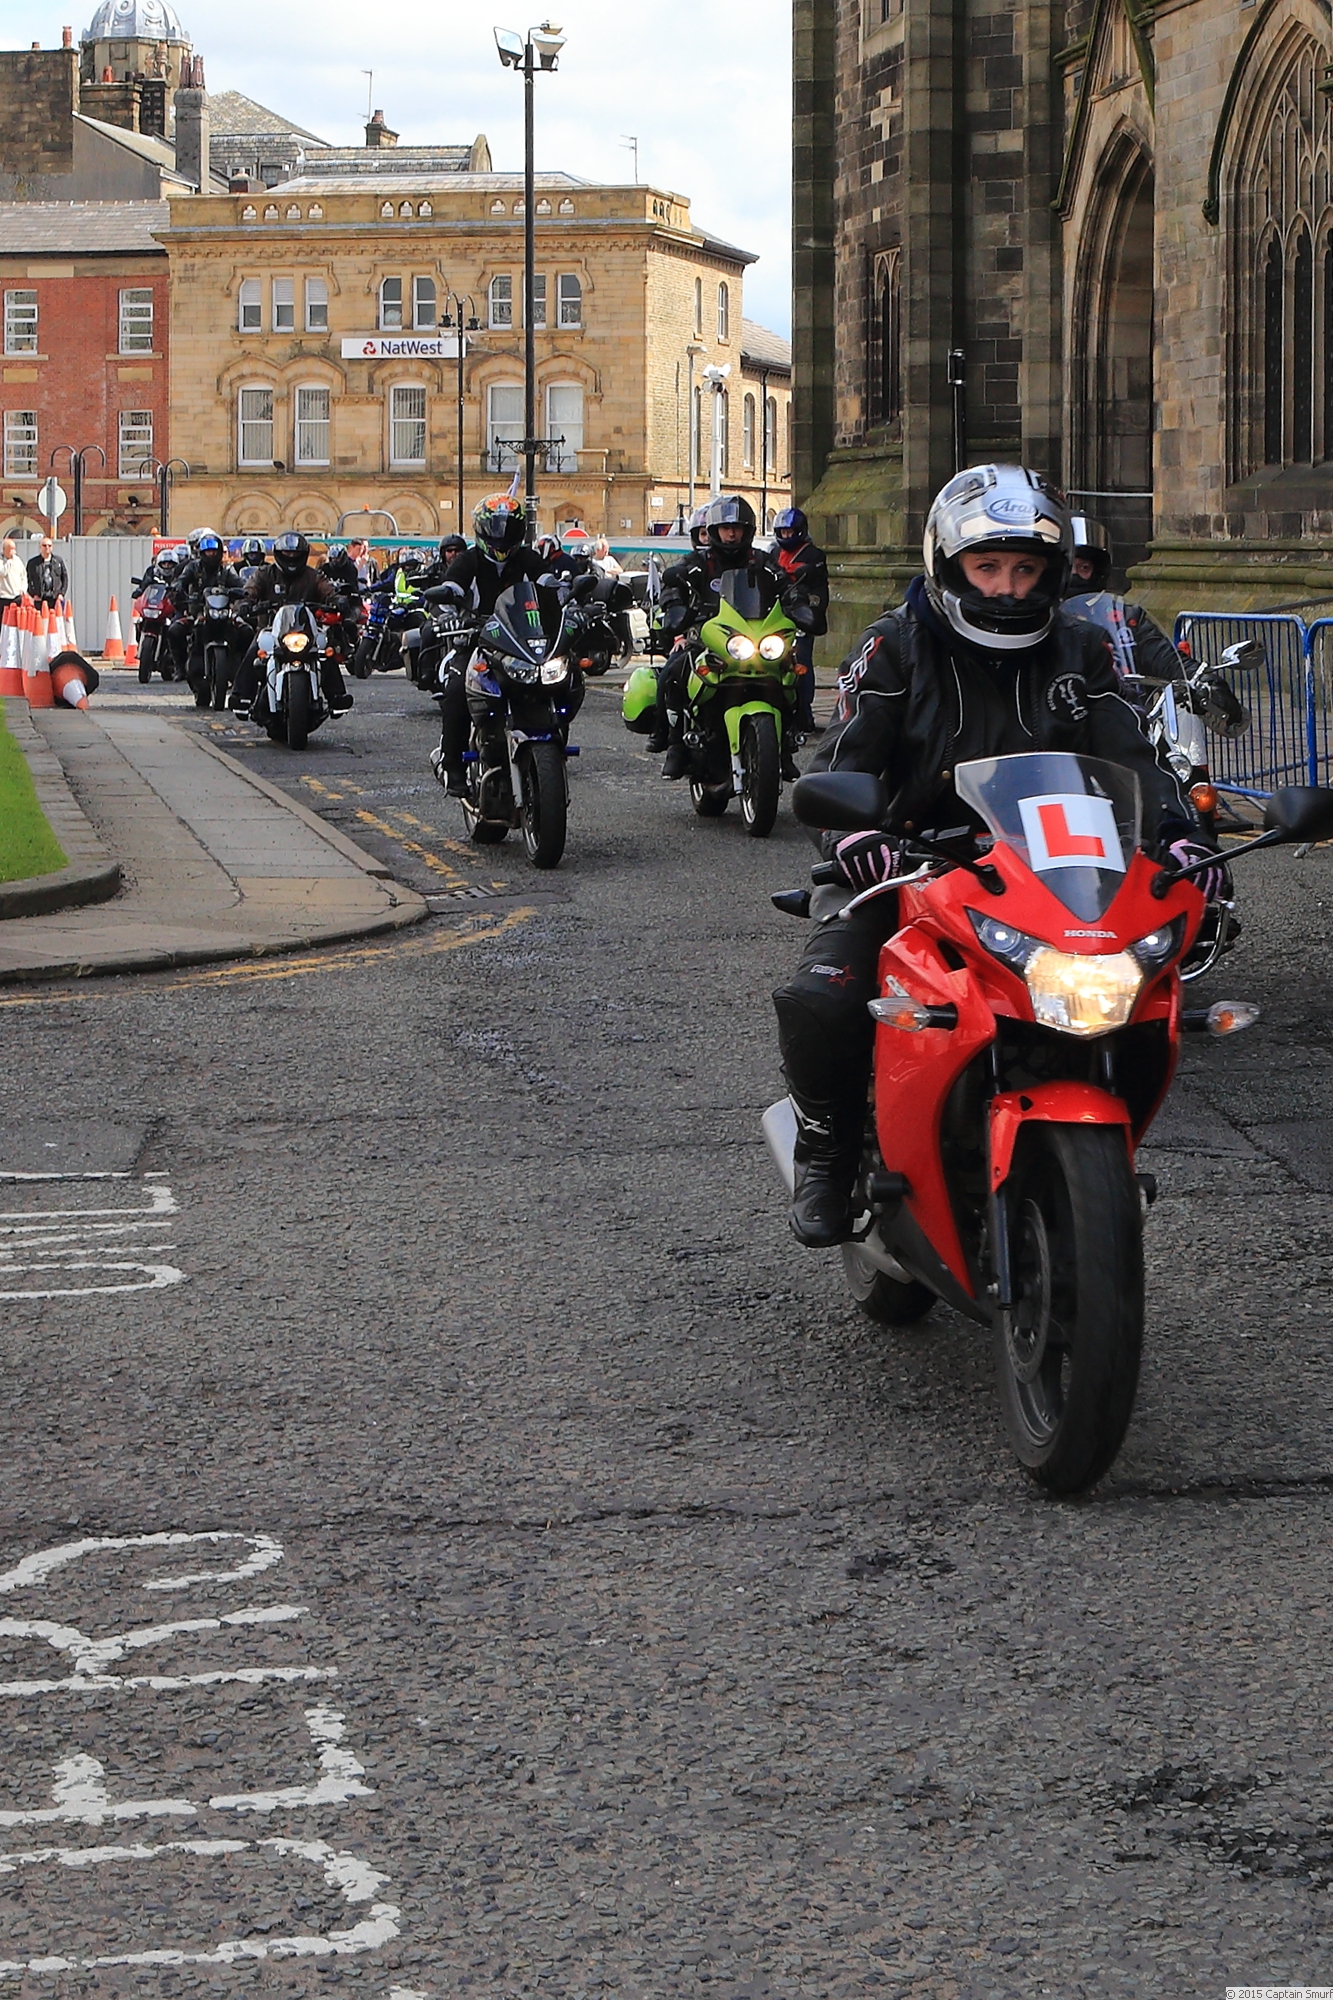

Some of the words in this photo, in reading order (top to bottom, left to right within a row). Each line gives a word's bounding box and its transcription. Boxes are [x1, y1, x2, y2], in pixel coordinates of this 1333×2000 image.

[381, 341, 443, 355] NatWest
[1037, 803, 1107, 858] L
[1063, 929, 1118, 939] HONDA
